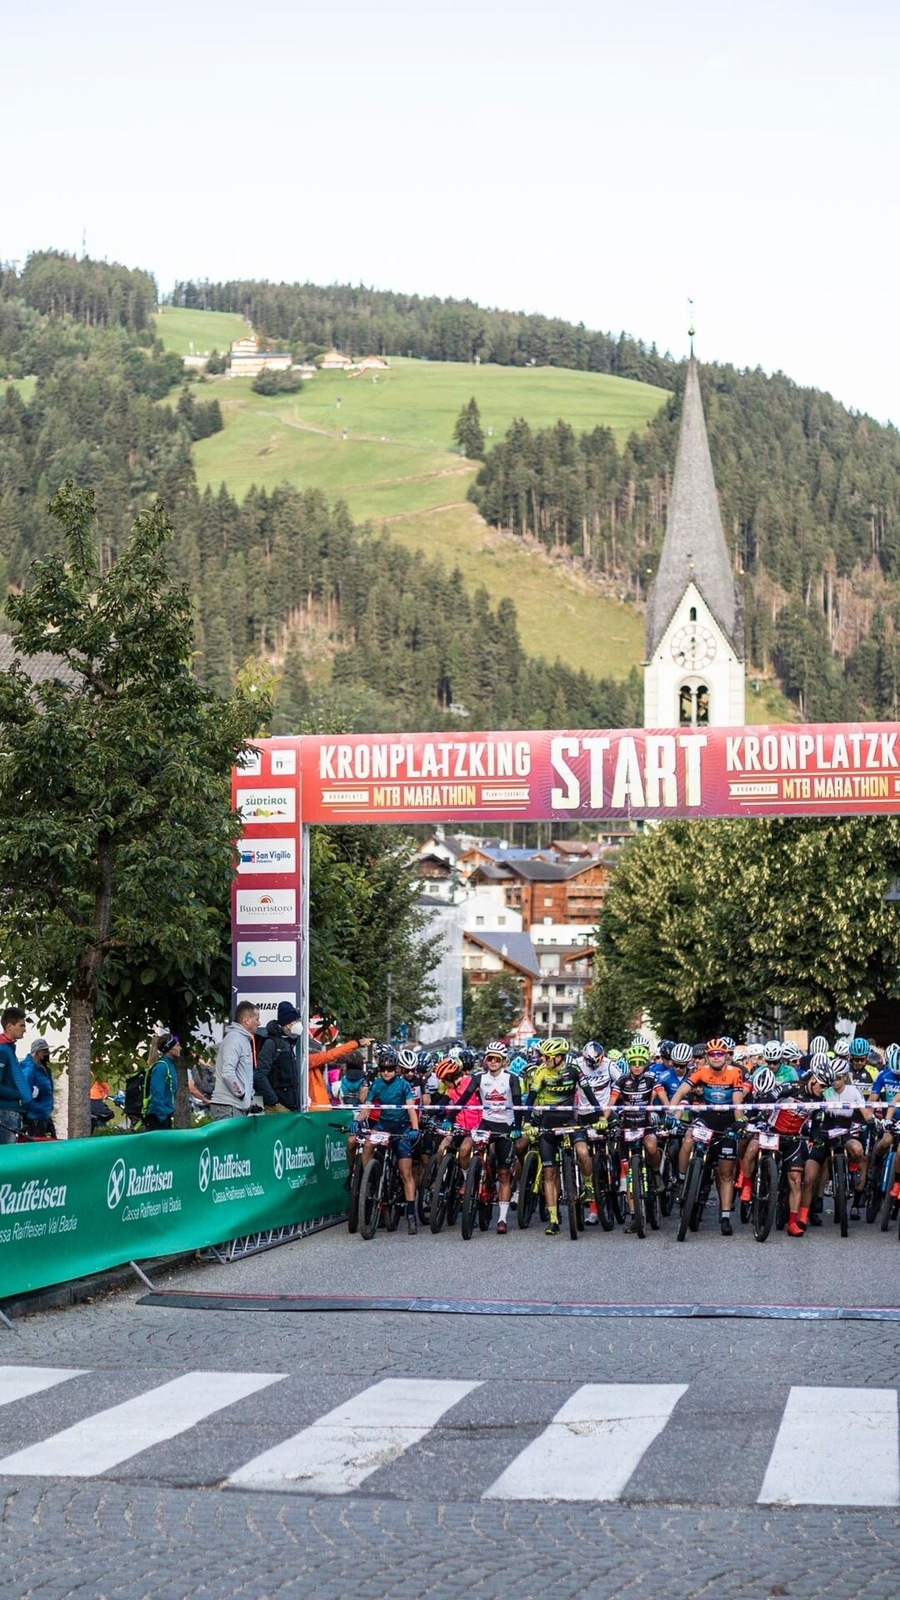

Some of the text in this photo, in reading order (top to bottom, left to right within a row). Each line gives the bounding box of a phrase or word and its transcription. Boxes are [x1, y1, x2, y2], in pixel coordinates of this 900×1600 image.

[320, 742, 530, 779] KRONPLATZKING
[725, 732, 899, 772] KRONPLATZK
[550, 735, 707, 809] START
[373, 785, 476, 807] MTB MARATHON
[782, 776, 889, 799] MTB MARATHON
[256, 851, 291, 862] San Vigilio
[258, 953, 292, 962] odlo
[126, 1165, 173, 1196] Raiffeisen
[212, 1154, 251, 1181] Raiffeisen
[0, 1178, 67, 1215] Raiffeisen
[212, 1188, 226, 1204] Cassa
[122, 1206, 139, 1222] Cassa
[140, 1200, 162, 1219] Raiffeisen
[162, 1198, 170, 1213] Val
[12, 1220, 47, 1241] Raiffeisen
[48, 1216, 60, 1235] Val
[58, 1214, 78, 1233] Badia
